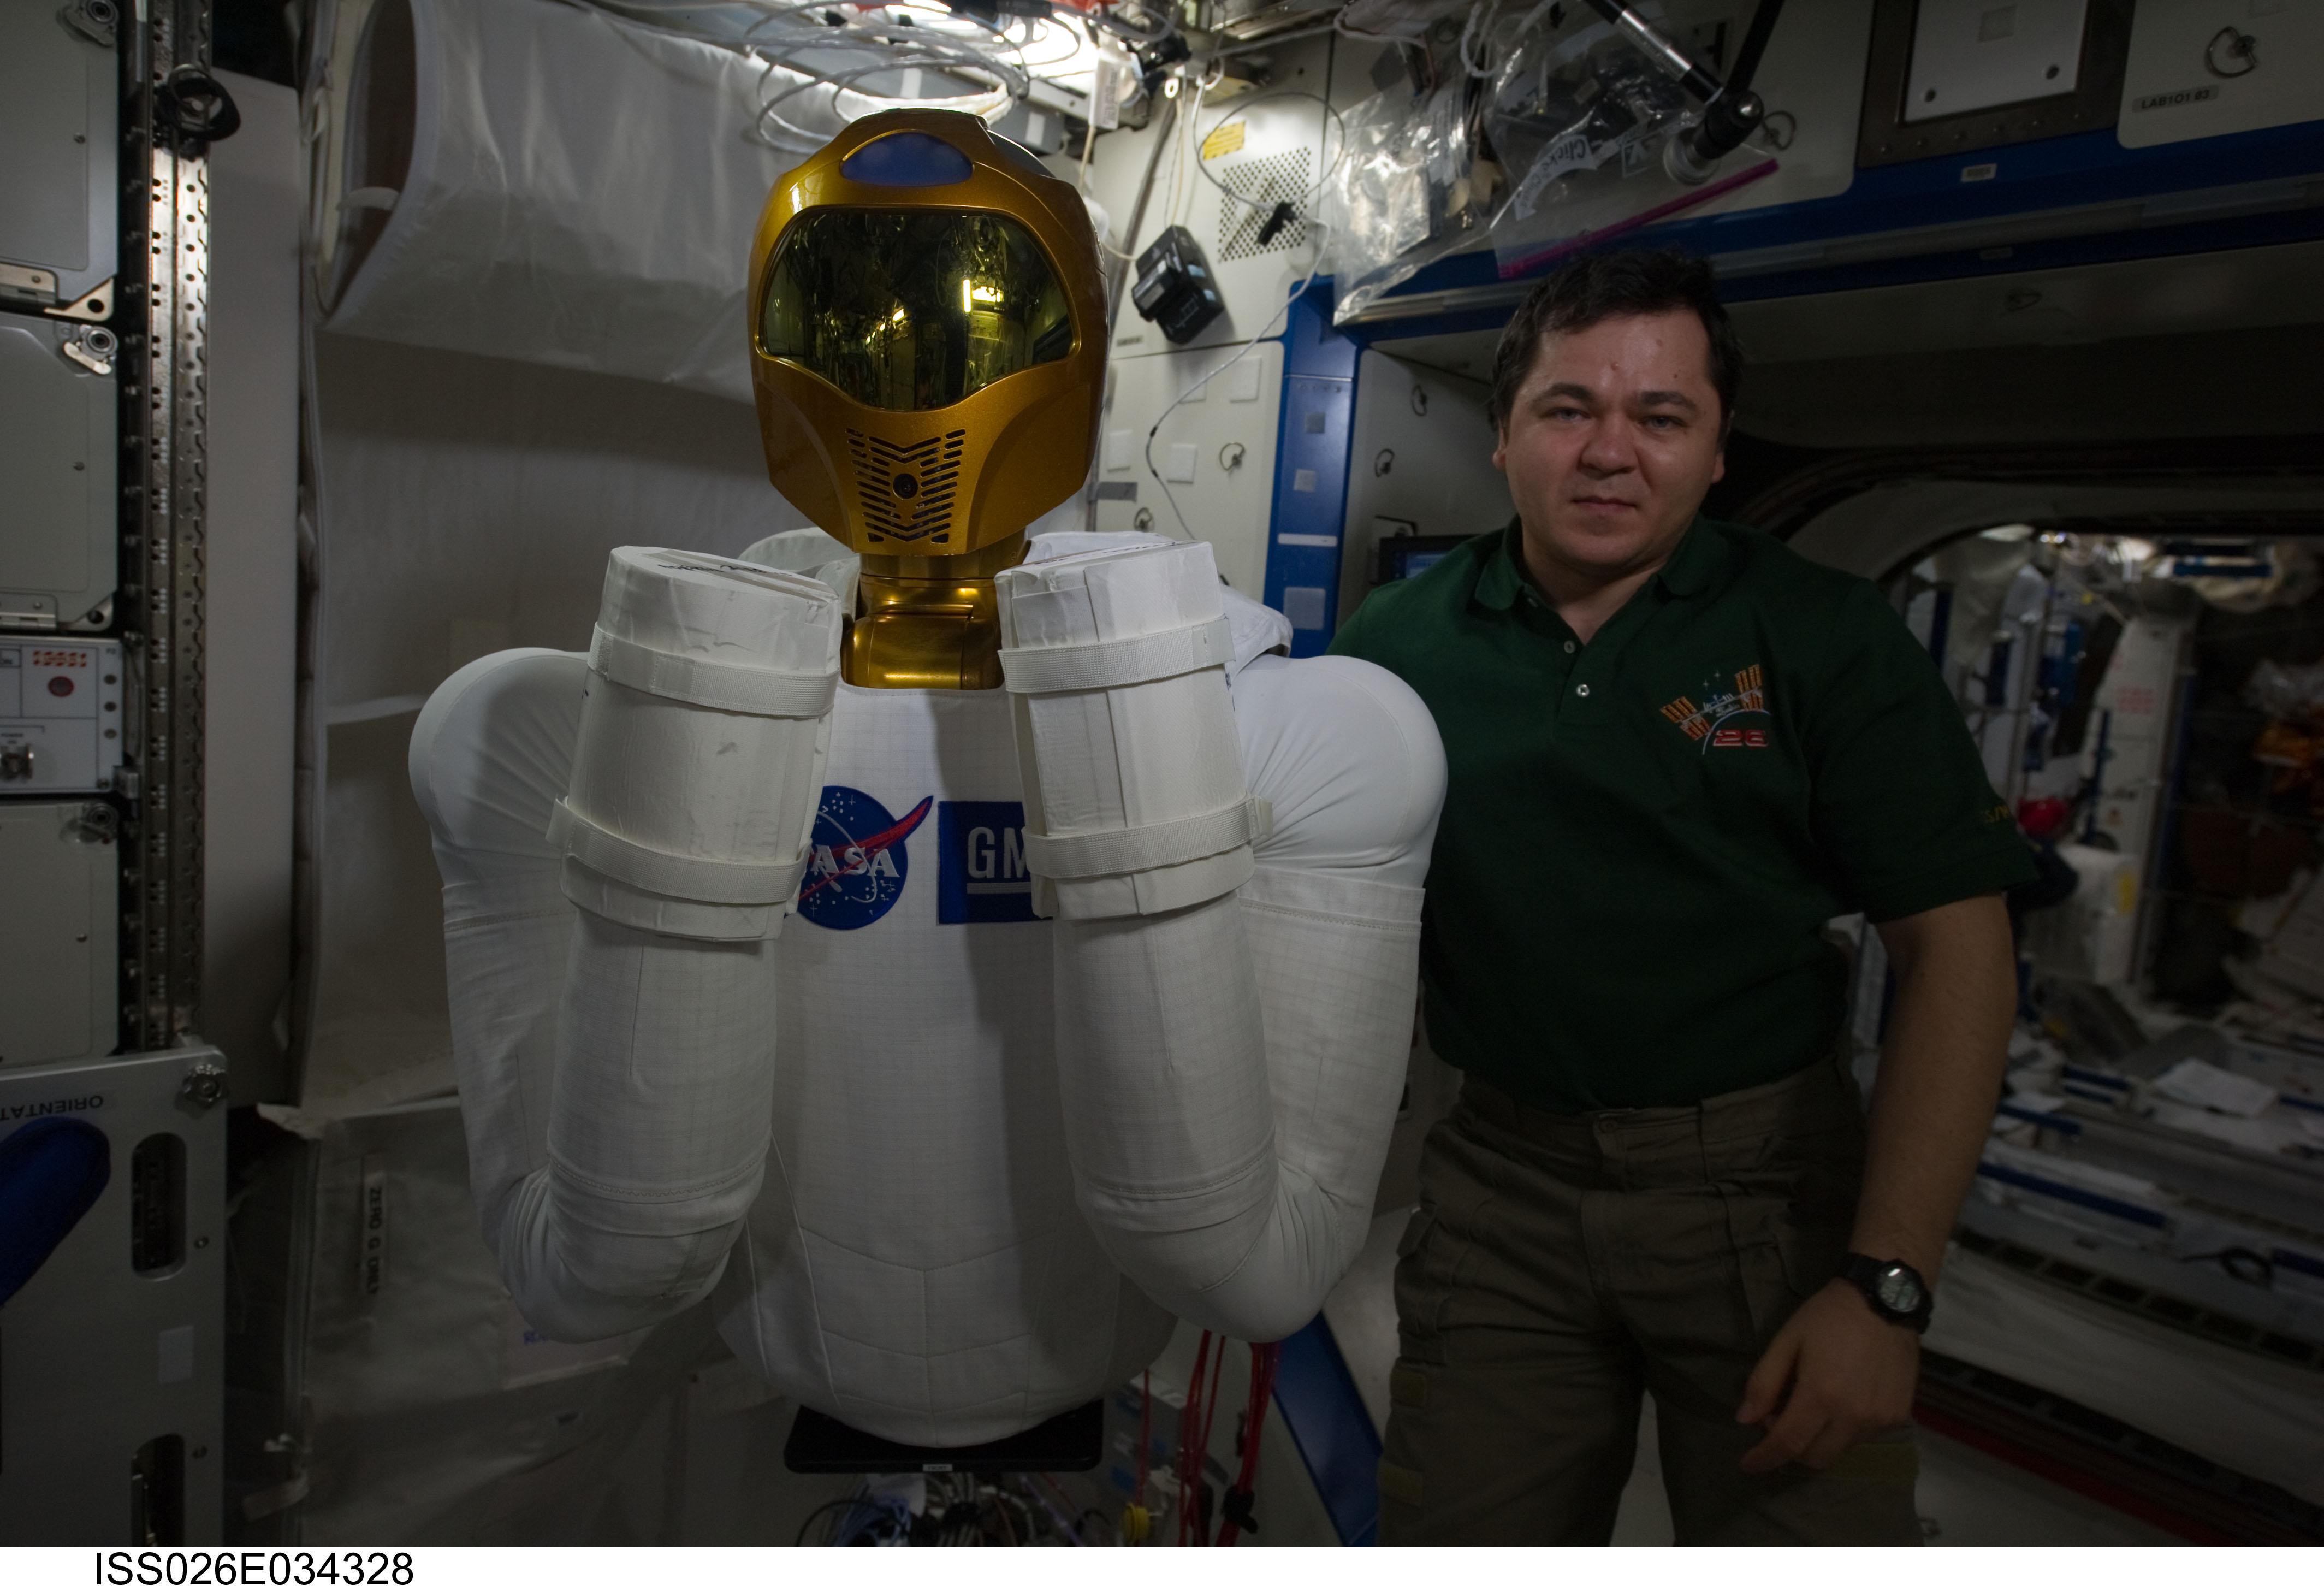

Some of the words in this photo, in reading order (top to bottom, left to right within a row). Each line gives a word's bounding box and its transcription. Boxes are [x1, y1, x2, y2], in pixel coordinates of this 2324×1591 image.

[1712, 729, 1769, 747] 26
[810, 844, 900, 878] ASA
[369, 1187, 383, 1229] ZERO
